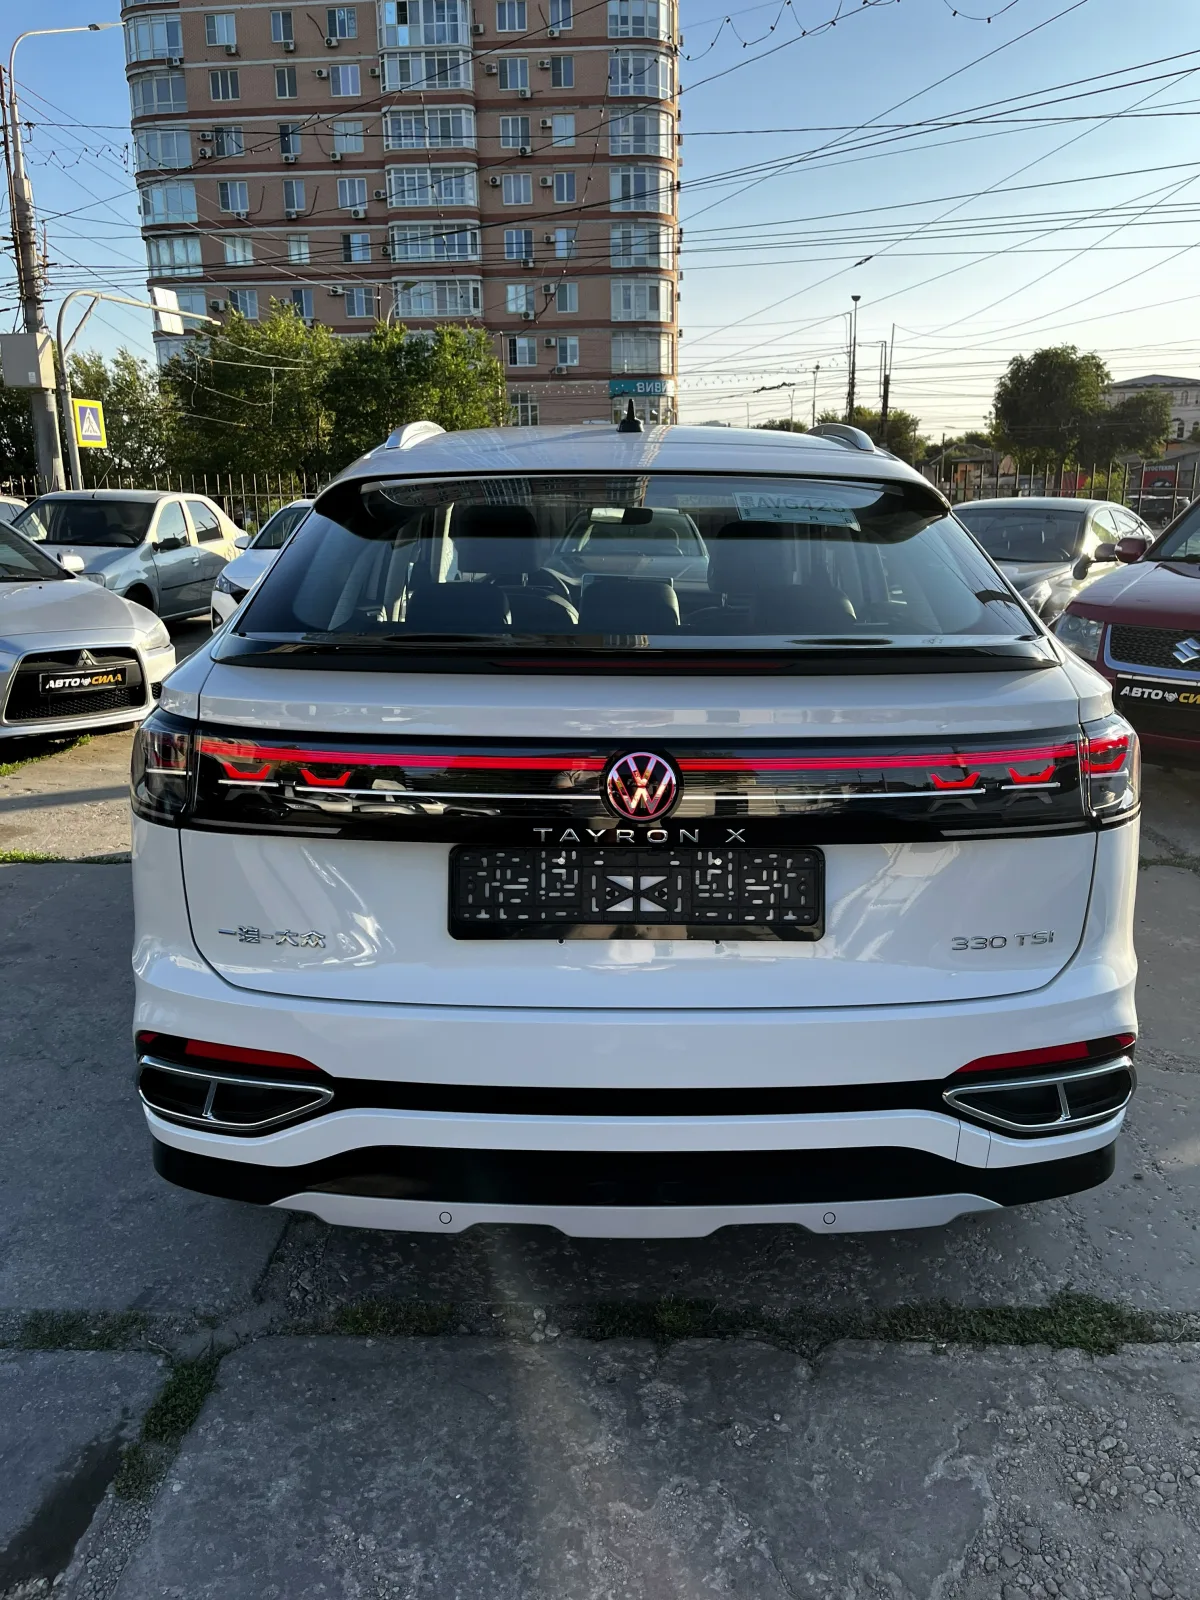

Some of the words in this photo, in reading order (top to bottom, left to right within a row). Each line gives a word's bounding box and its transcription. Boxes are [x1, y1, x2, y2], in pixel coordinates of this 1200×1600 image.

[1142, 464, 1176, 472] ВТОСТЕКЛО
[45, 677, 81, 689] АВТО
[91, 673, 123, 685] СИЛА
[1120, 686, 1164, 700] АВТО
[533, 827, 700, 844] TAYRON
[725, 828, 747, 844] X
[951, 935, 1008, 951] 330
[1014, 929, 1056, 947] TSI
